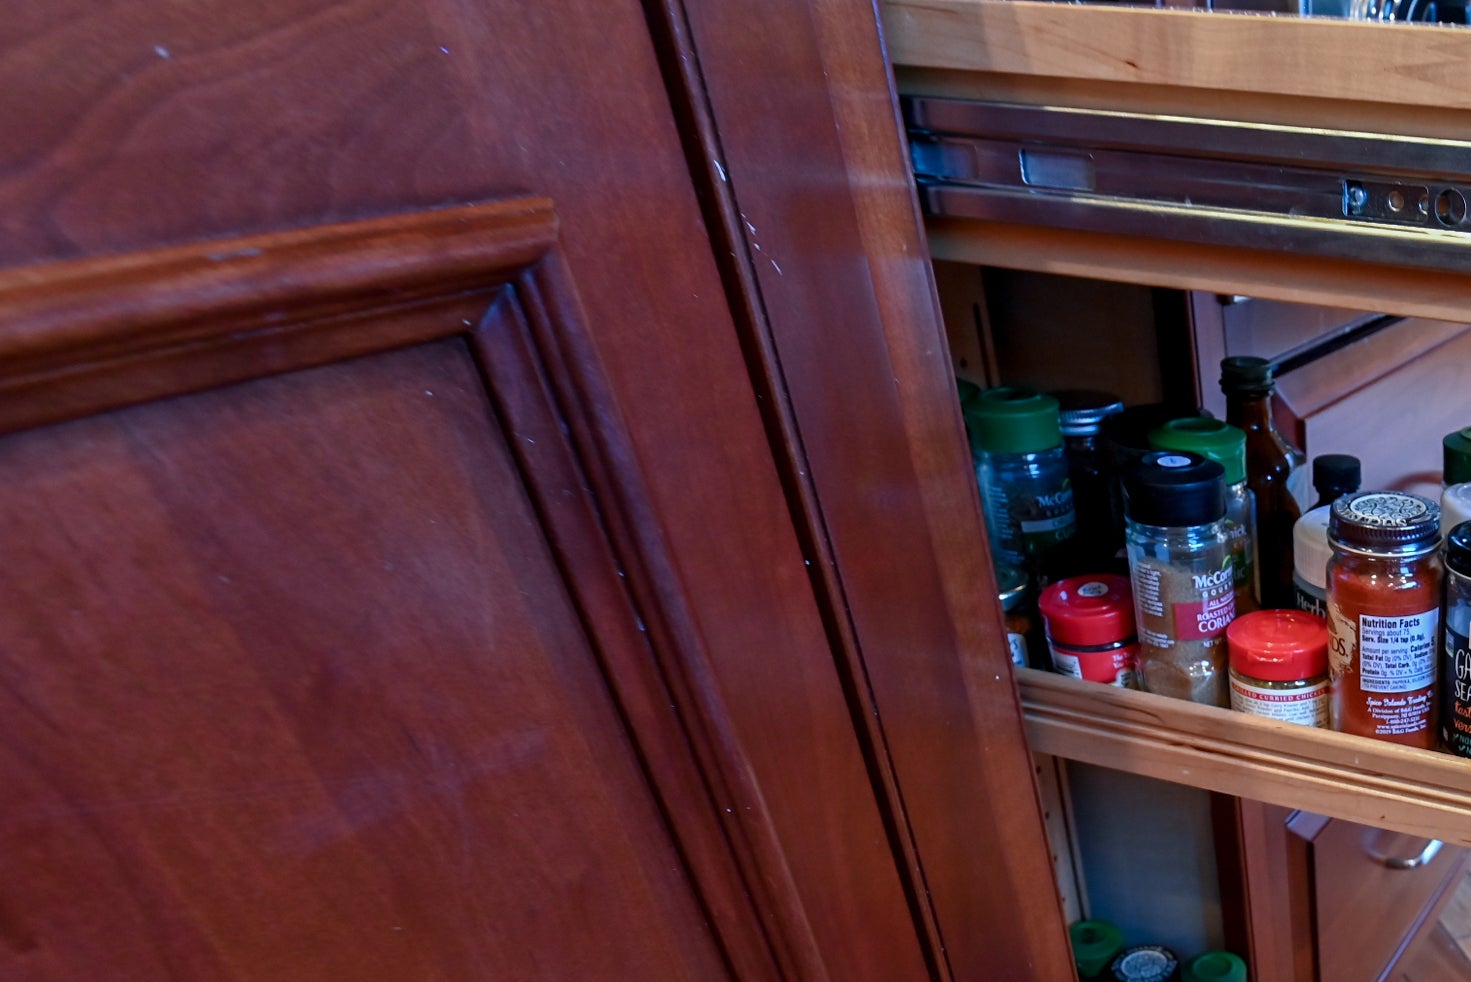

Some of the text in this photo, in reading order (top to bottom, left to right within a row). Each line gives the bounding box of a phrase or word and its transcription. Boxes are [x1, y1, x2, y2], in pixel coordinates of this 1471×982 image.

[1362, 617, 1420, 628] Nutrition Facts
[1387, 628, 1402, 636] about
[1378, 635, 1388, 644] Size
